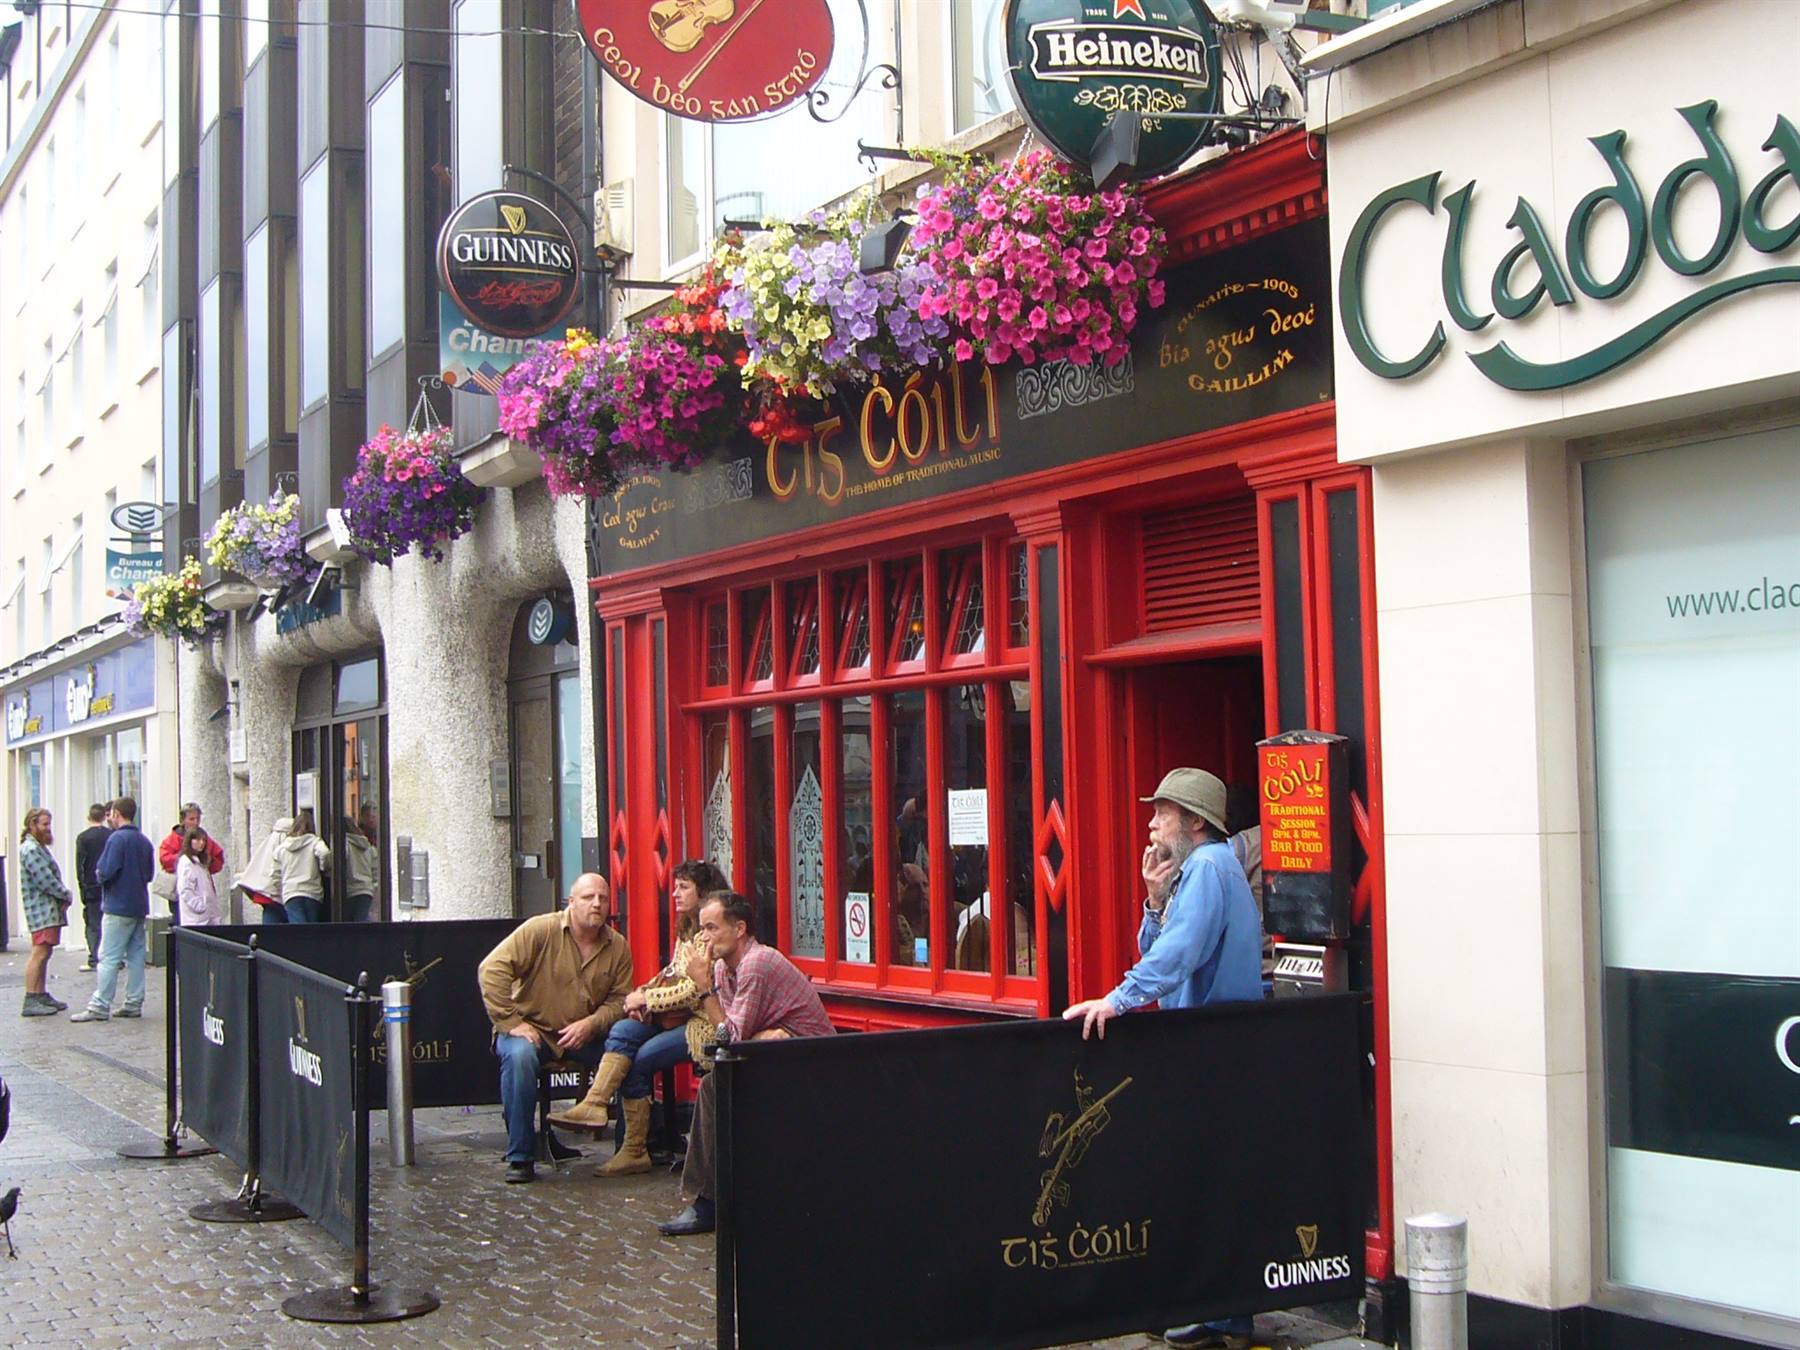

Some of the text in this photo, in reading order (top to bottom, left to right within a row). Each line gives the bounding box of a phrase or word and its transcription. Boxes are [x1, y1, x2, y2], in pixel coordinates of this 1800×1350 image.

[1046, 31, 1201, 75] Heineken
[452, 233, 572, 270] GUINNESS
[1263, 278, 1299, 300] 1905
[845, 448, 1001, 498] THE HOME OF TRADITIONAL MUSIC
[118, 557, 153, 567] Bureau
[1280, 819, 1317, 830] SESSION
[1271, 840, 1324, 853] BAR FOOD
[1281, 856, 1313, 869] DAILY
[1264, 1255, 1351, 1290] GUINNESS
